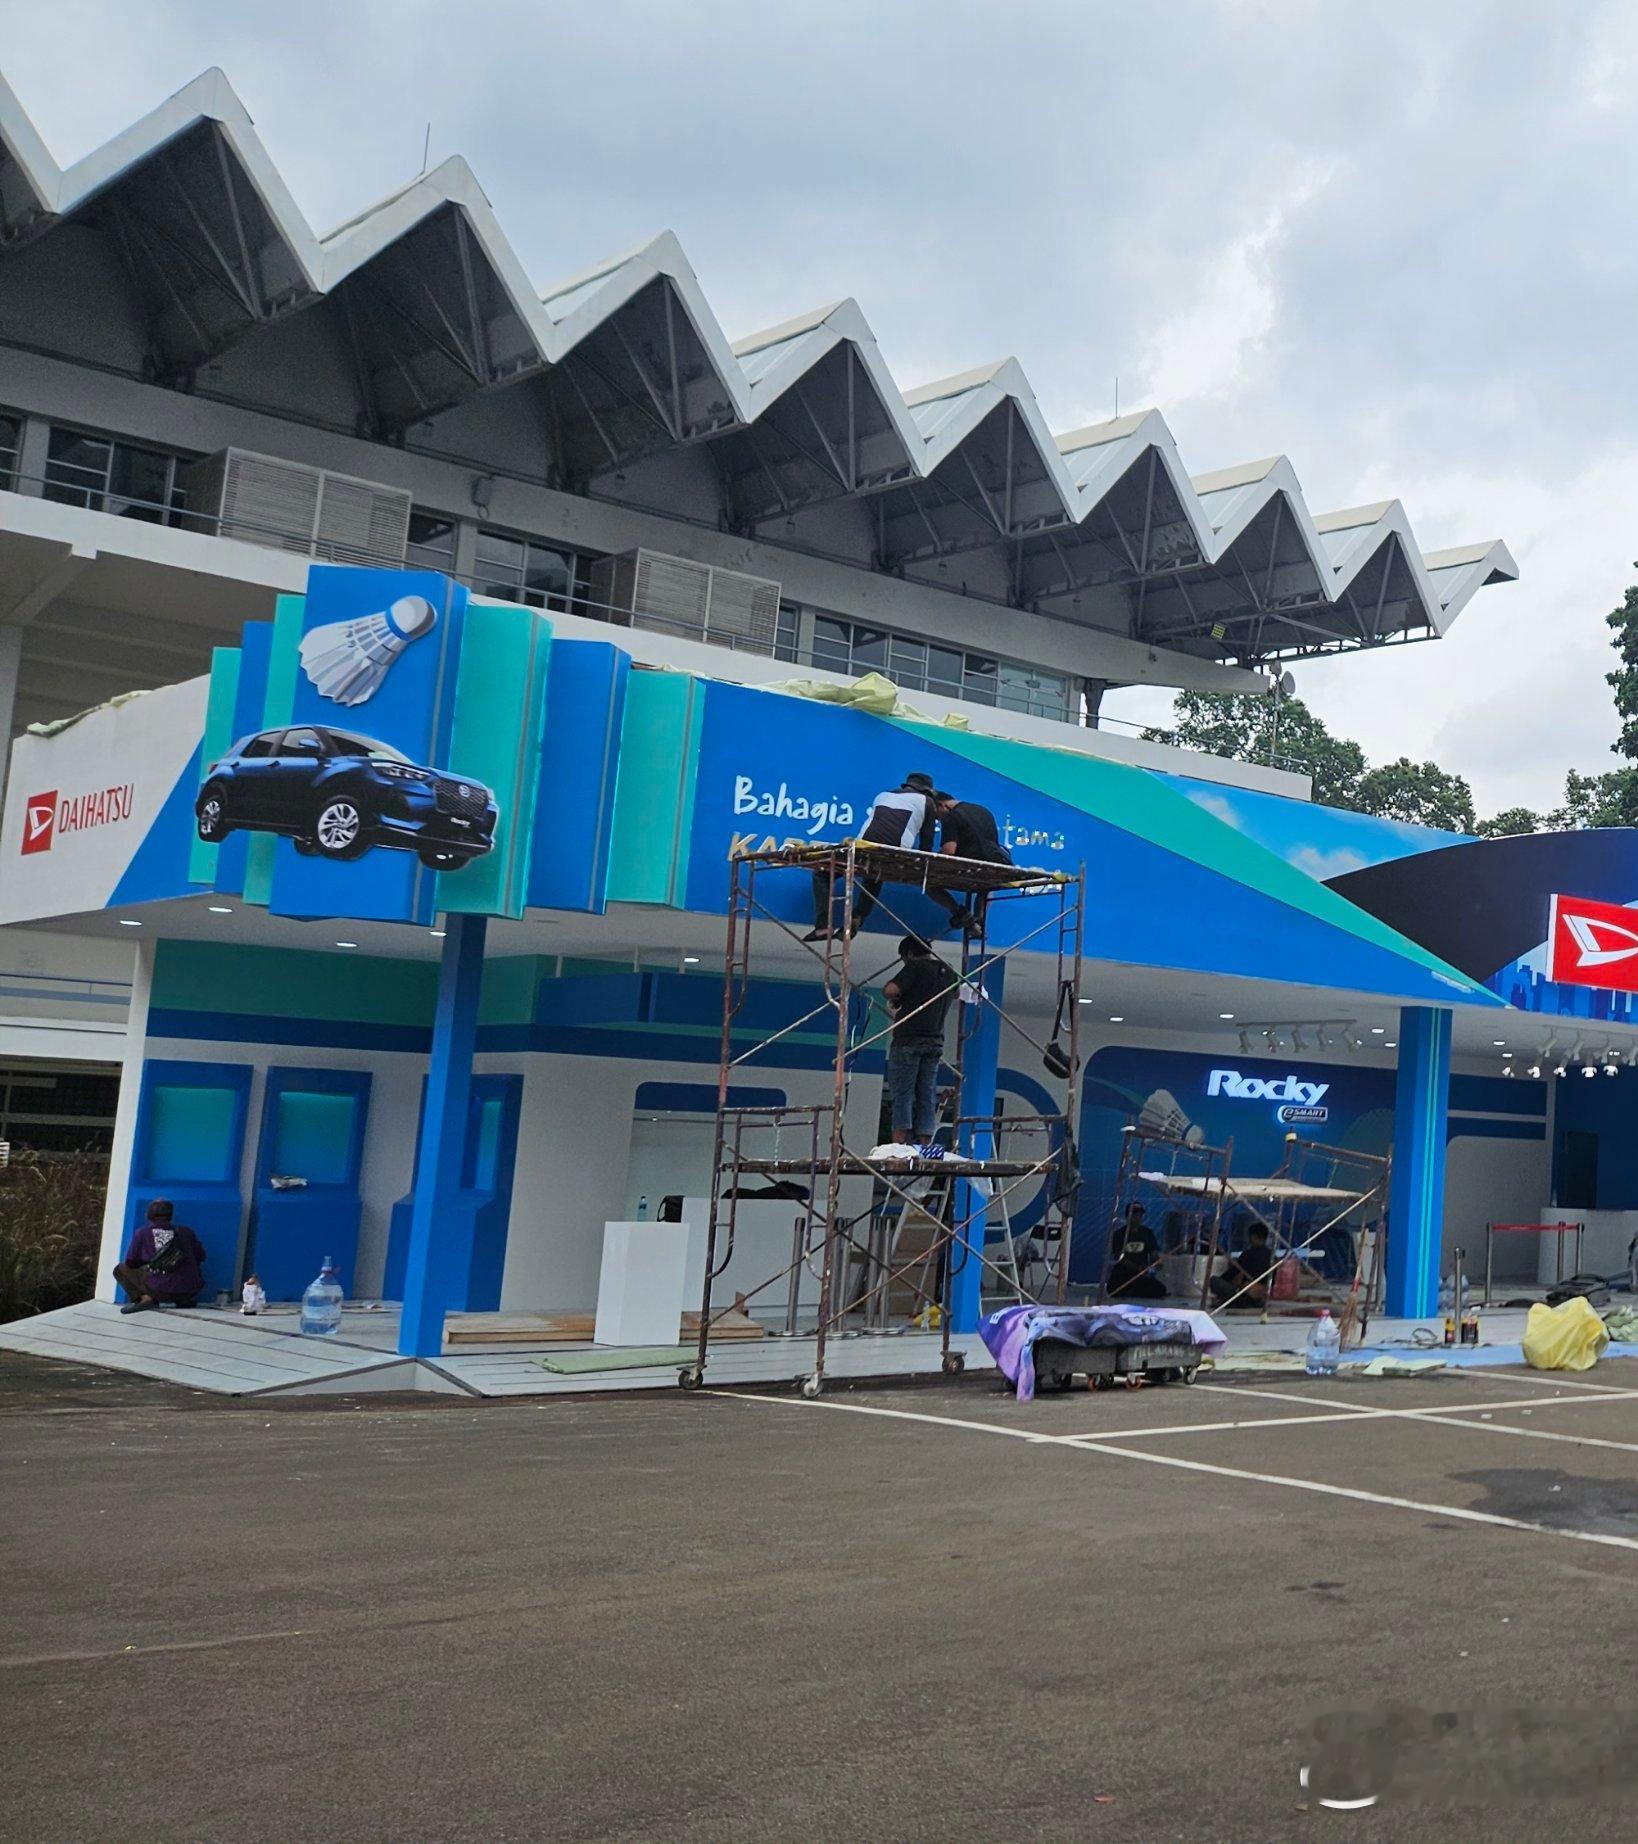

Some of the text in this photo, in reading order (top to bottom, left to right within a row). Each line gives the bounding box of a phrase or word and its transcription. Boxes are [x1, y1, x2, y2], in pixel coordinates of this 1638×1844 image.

[59, 783, 134, 833] DAIHATSU
[734, 775, 853, 835] Bahagia
[1207, 1069, 1330, 1106] Rocky
